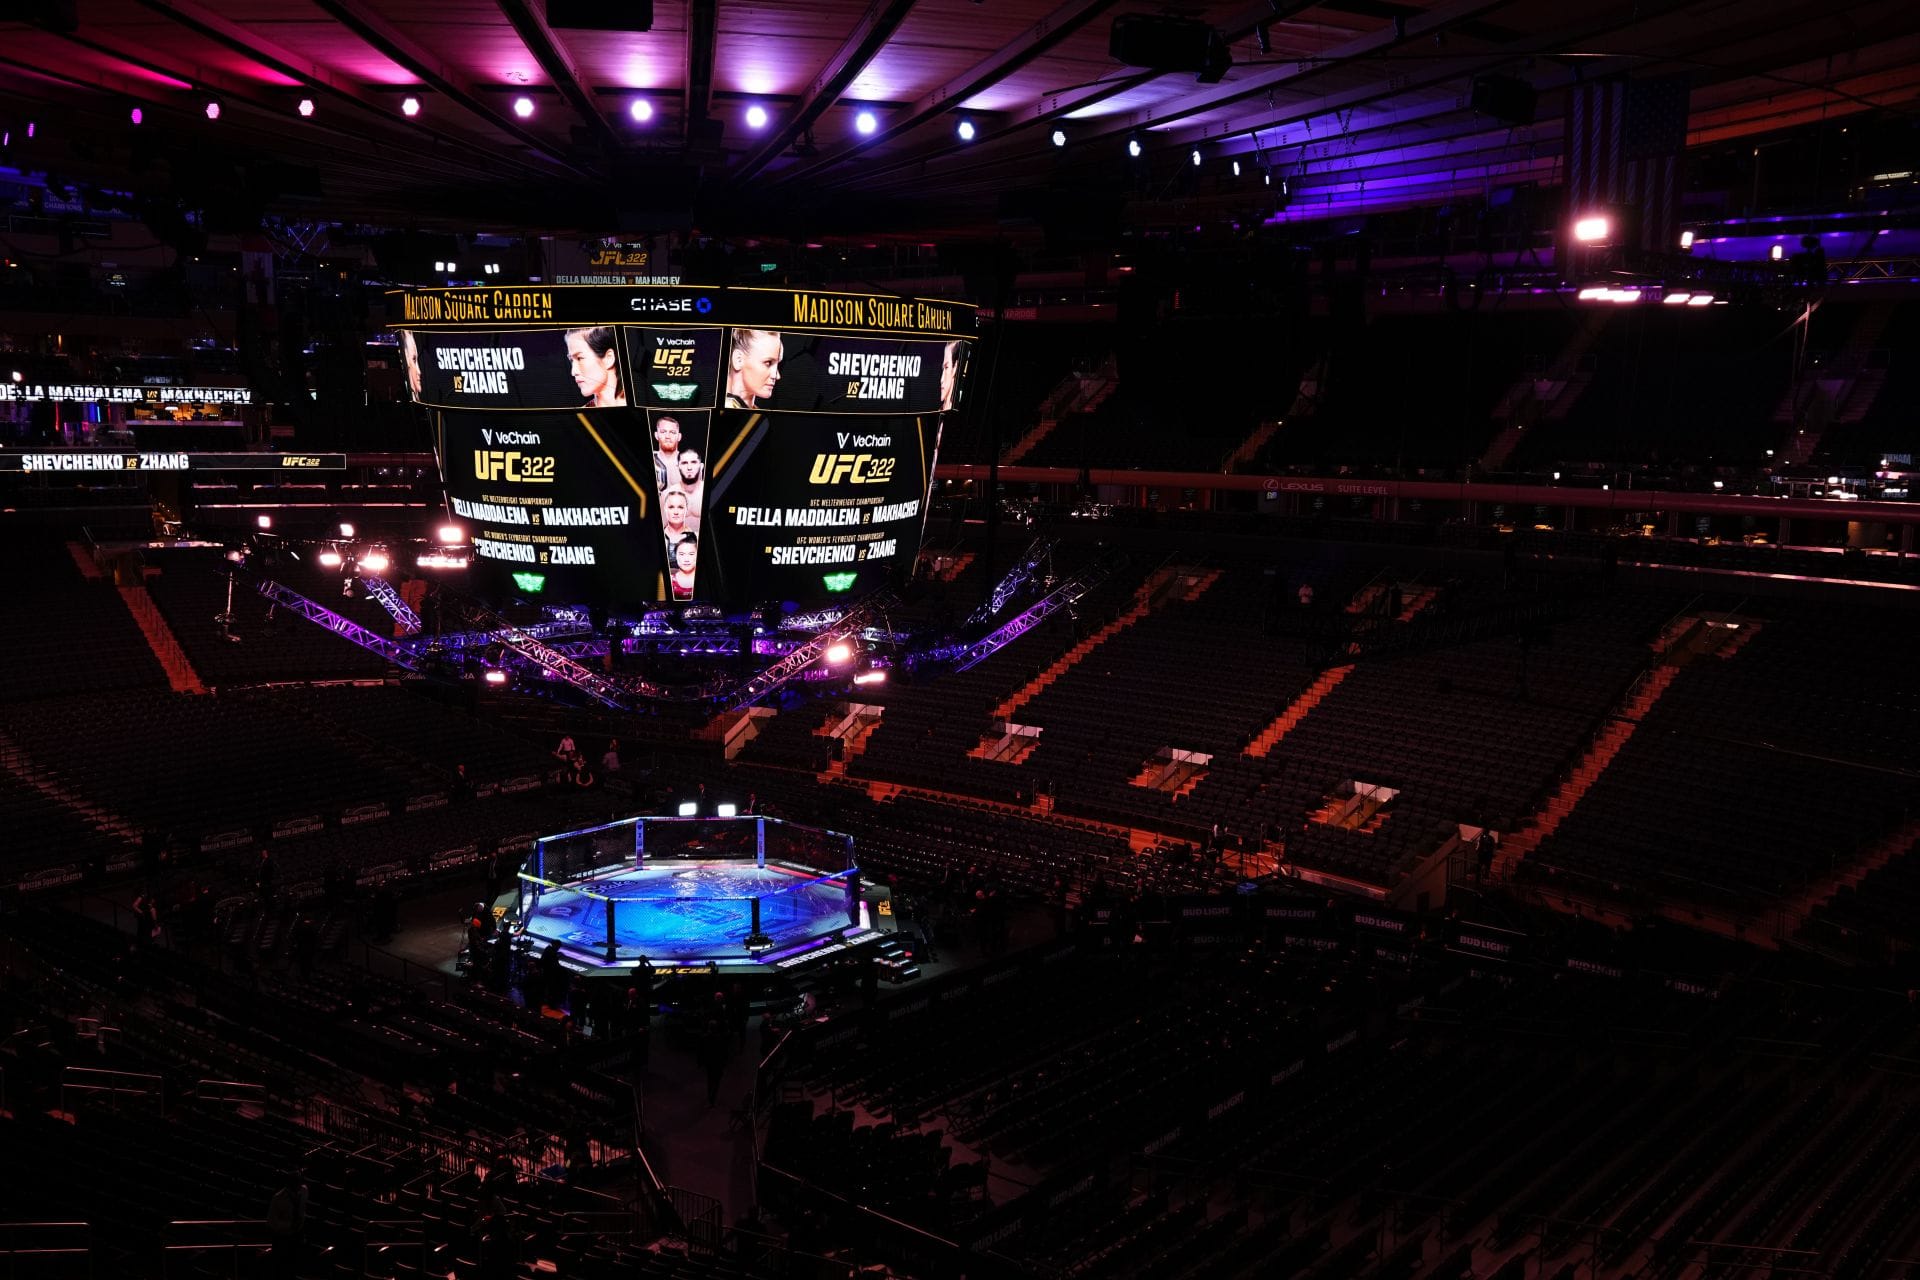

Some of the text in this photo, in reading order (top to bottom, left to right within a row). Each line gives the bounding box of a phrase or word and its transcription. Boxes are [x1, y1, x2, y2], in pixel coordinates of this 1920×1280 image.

[627, 253, 647, 263] 322
[556, 275, 579, 285] DELLA
[580, 275, 626, 285] MADDALENA
[404, 290, 552, 321] MADISON SQUARE GARDEN
[631, 298, 692, 311] CHASE
[794, 294, 952, 330] MADISON SQUARE GARDEN
[436, 347, 525, 370] SHEVCHENKO
[653, 348, 695, 365] UFC
[828, 352, 921, 377] SHEVCHENKO
[666, 366, 691, 376] 322
[454, 372, 508, 394] VS ZHANG
[847, 377, 904, 399] VS ZHANG
[48, 386, 143, 402] MADDALENA
[161, 388, 251, 403] MAKHACHEV
[495, 430, 541, 444] VeChain
[853, 434, 891, 447] VeChain
[22, 454, 189, 470] SHEVCHENKO VS ZHANG
[282, 456, 307, 466] UFC
[474, 450, 555, 482] UFC 322
[809, 454, 896, 484] UFC 322
[1280, 482, 1388, 495] LEXUS SUITE LEVEL
[454, 497, 629, 525] DELLA MADDALENA VS MAKHACHEV
[736, 499, 920, 526] DELLA MADDALENA VS MAKHACHEV
[539, 551, 548, 564] VS
[549, 545, 595, 565] ZHANG
[771, 539, 897, 565] SHEVCHENKO VS ZHANG
[1182, 907, 1230, 916] BUD LIGHT
[1266, 909, 1316, 918] BUD LIGHT
[1355, 914, 1404, 931] BUD LIGHT
[1460, 935, 1511, 954] BUD LIGHT
